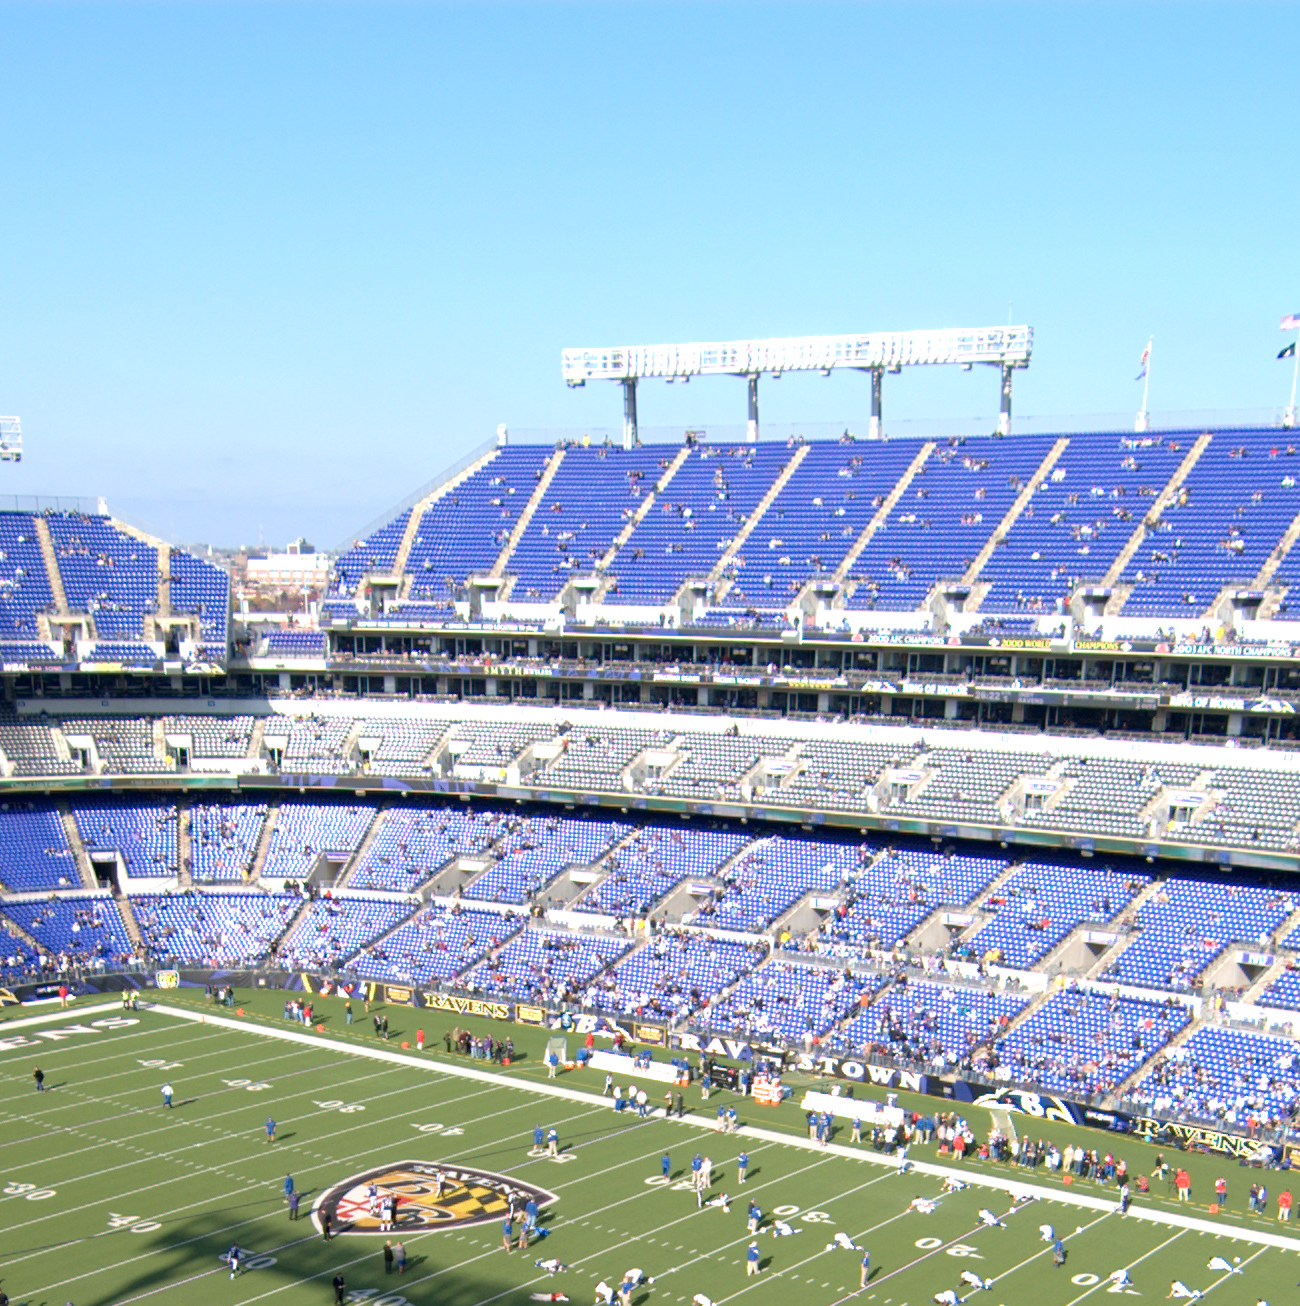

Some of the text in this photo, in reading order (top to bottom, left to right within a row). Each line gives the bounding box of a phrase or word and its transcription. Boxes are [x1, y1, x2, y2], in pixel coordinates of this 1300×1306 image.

[891, 635, 904, 644] AFC
[905, 635, 945, 645] CHAMPIONS
[1025, 639, 1051, 648] WORLD
[1075, 640, 1119, 650] CHAMPIONS
[1198, 645, 1213, 655] AFC
[1214, 646, 1242, 656] NORTH
[1243, 647, 1292, 658] CHAMPIONS
[484, 666, 522, 675] SMYTH
[924, 683, 936, 694] OF
[937, 684, 969, 696] HONOR
[1195, 697, 1209, 708] OF
[1210, 698, 1245, 710] HONOR
[423, 993, 510, 1019] RAVENS
[1135, 1117, 1263, 1159] RAVENS
[3, 1181, 57, 1201] 30
[773, 1203, 828, 1223] 30
[107, 1212, 163, 1234] 40
[914, 1237, 976, 1258] 20
